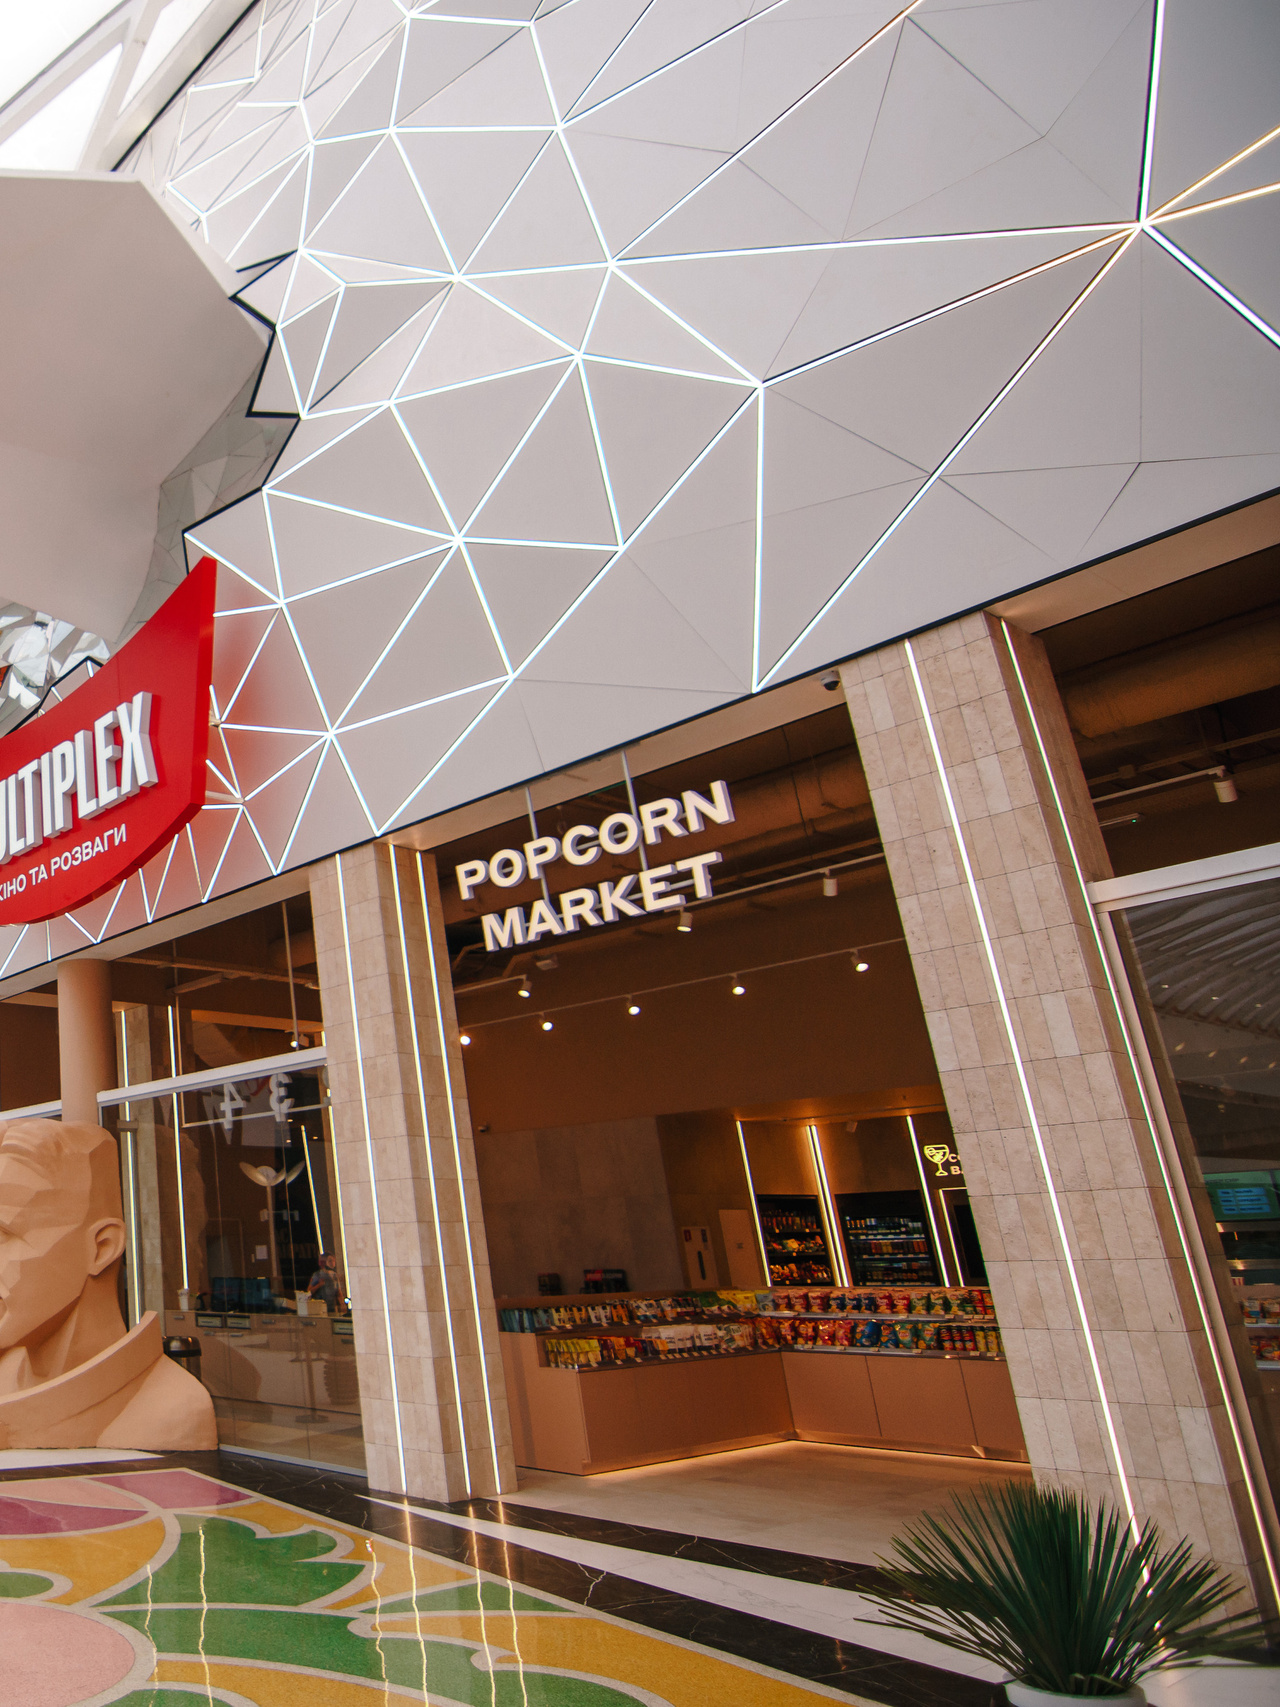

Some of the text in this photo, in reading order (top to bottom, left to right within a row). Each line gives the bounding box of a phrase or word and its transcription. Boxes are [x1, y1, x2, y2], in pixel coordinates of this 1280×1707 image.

[29, 864, 49, 886] ТА
[51, 823, 127, 876] РОЗВАГИ
[455, 780, 735, 900] POPCORN
[481, 851, 723, 952] MARKET
